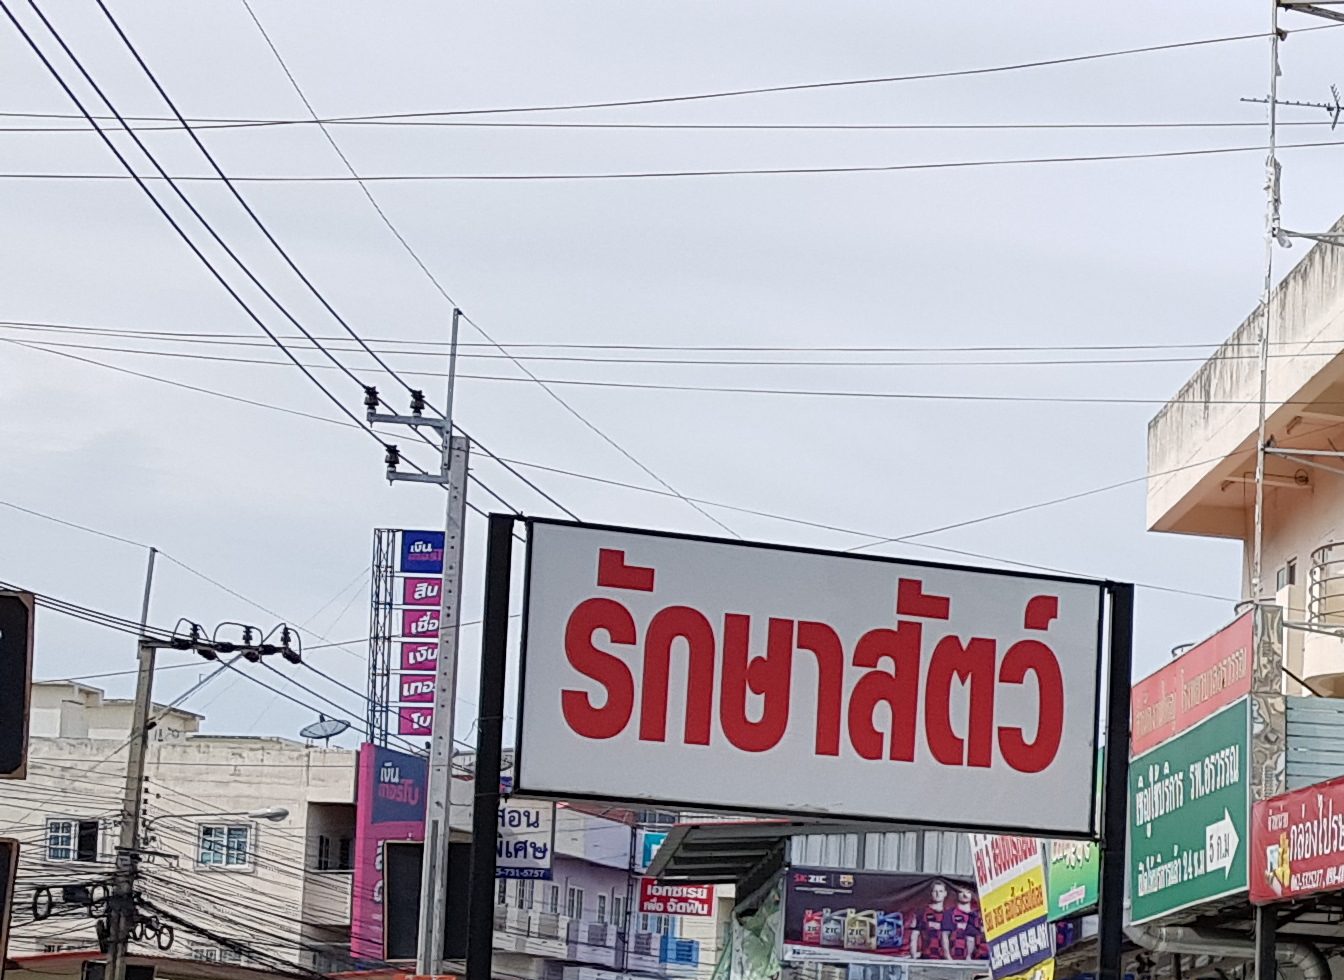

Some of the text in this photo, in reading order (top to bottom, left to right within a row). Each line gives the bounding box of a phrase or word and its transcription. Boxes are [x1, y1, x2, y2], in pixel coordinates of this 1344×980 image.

[561, 548, 1064, 773] รักษาสัตว์
[808, 874, 827, 884] ZIC
[825, 926, 840, 934] ZIC
[848, 928, 865, 936] ZIC
